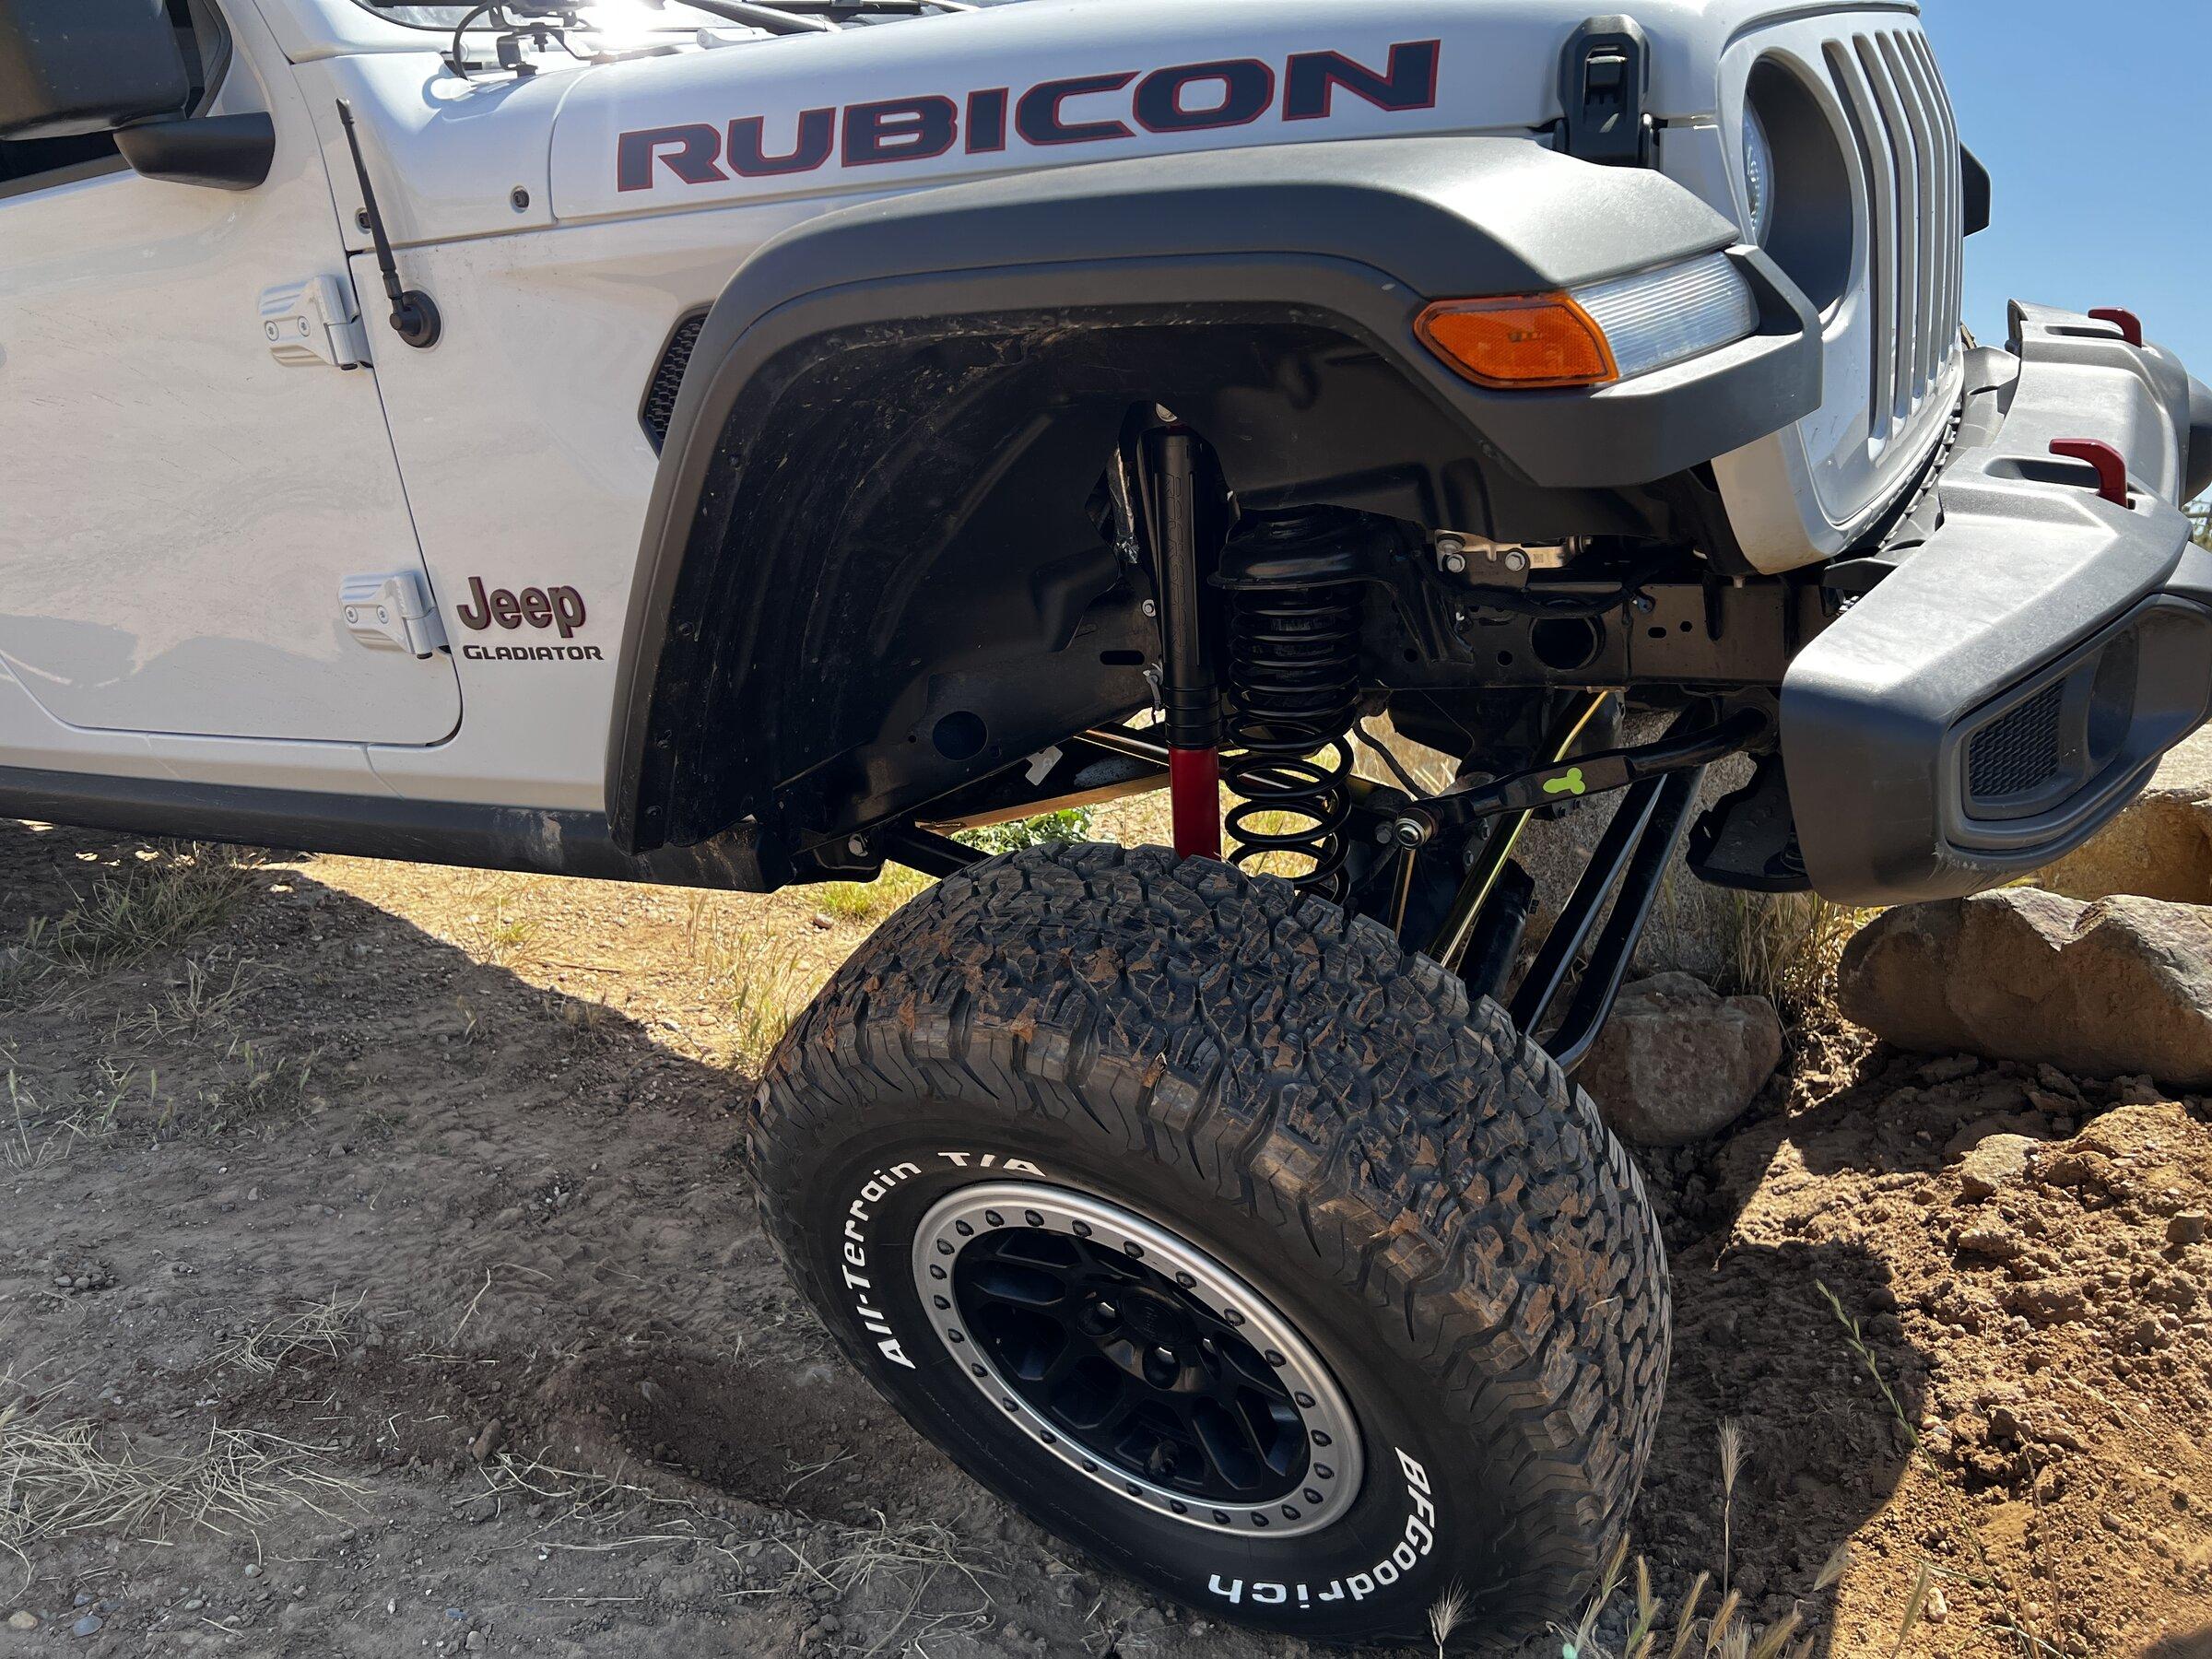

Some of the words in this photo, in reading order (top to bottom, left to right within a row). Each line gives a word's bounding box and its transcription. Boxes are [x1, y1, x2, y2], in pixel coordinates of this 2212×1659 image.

[618, 39, 1440, 192] RUBICON
[456, 576, 586, 638] Jeep
[463, 645, 605, 661] GLADIATOR
[841, 1161, 922, 1369] All-Terrain
[937, 1152, 1046, 1177] T/A
[1208, 1447, 1435, 1609] BFGoodrich
